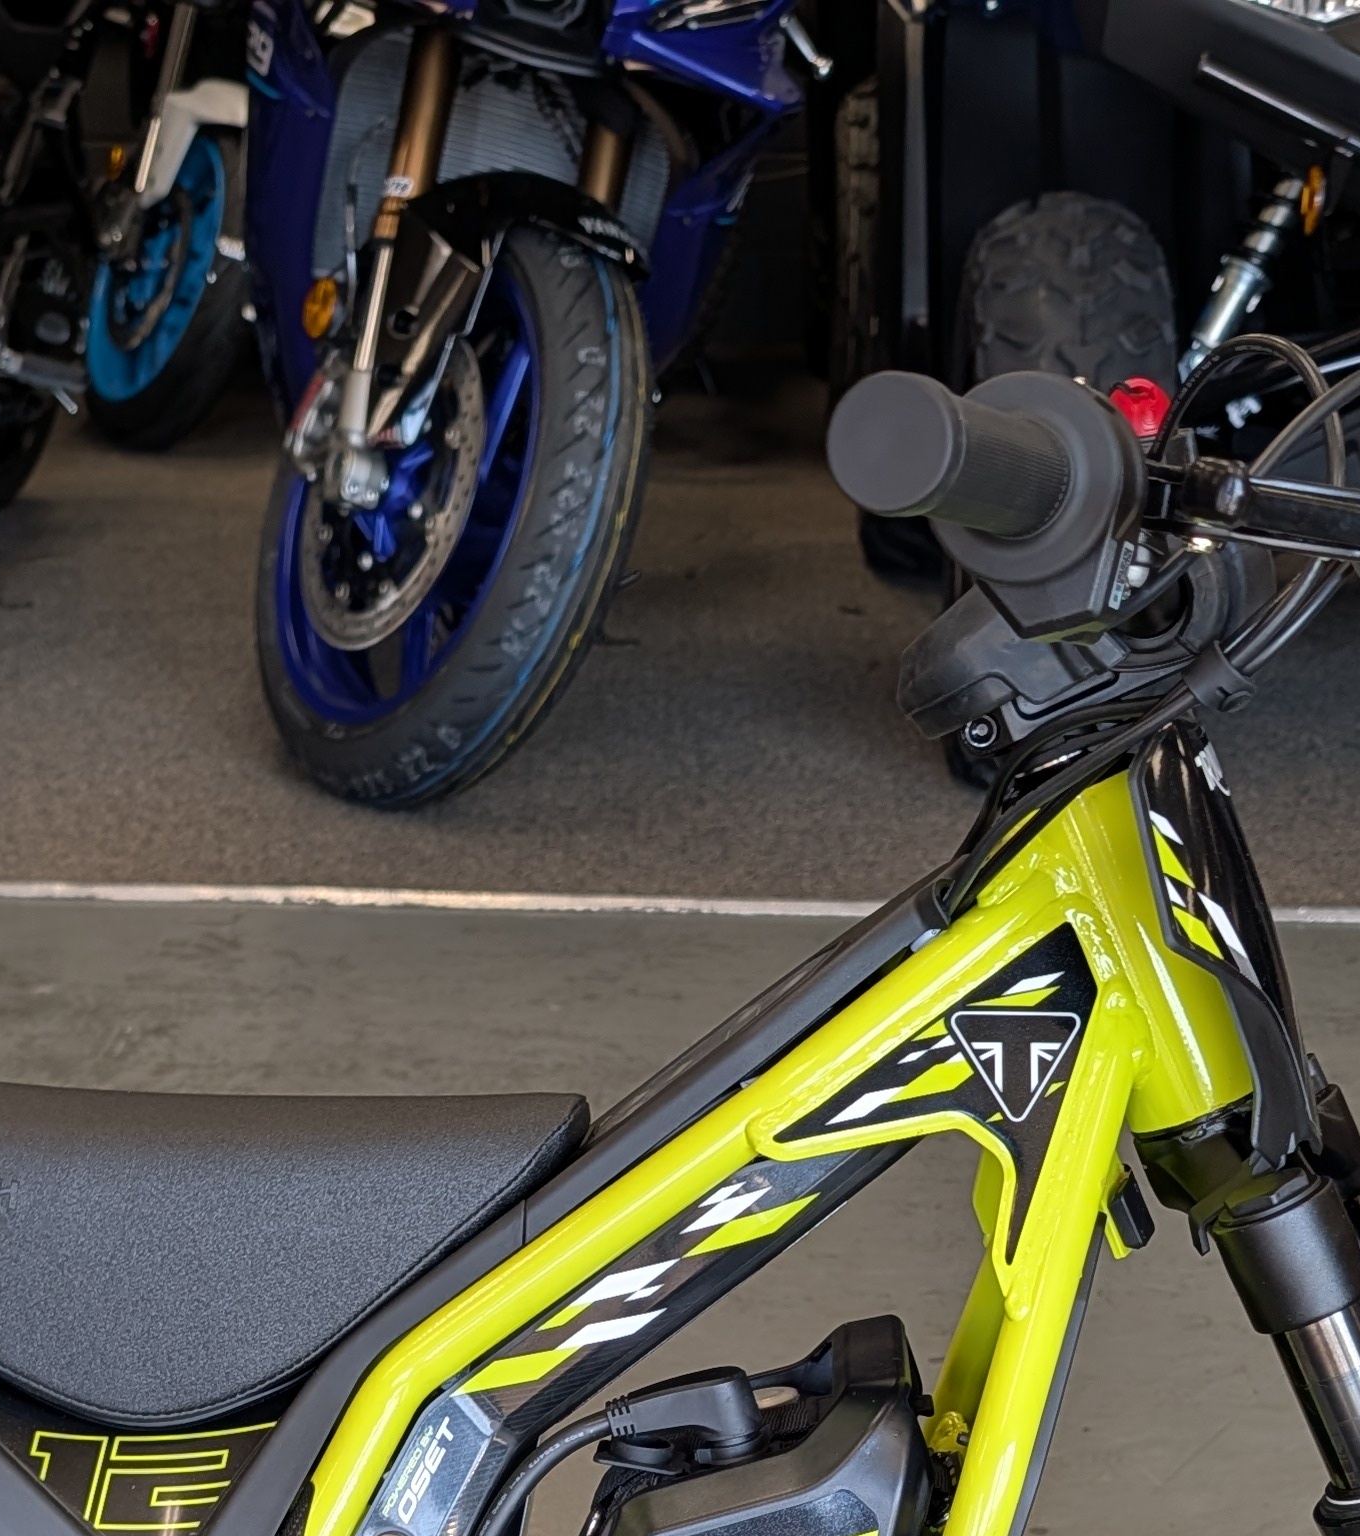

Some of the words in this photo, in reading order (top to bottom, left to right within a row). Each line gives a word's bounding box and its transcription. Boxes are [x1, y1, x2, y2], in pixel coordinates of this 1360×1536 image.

[381, 1447, 423, 1518] POWERED
[420, 1425, 434, 1448] BY
[397, 1416, 454, 1525] OSET
